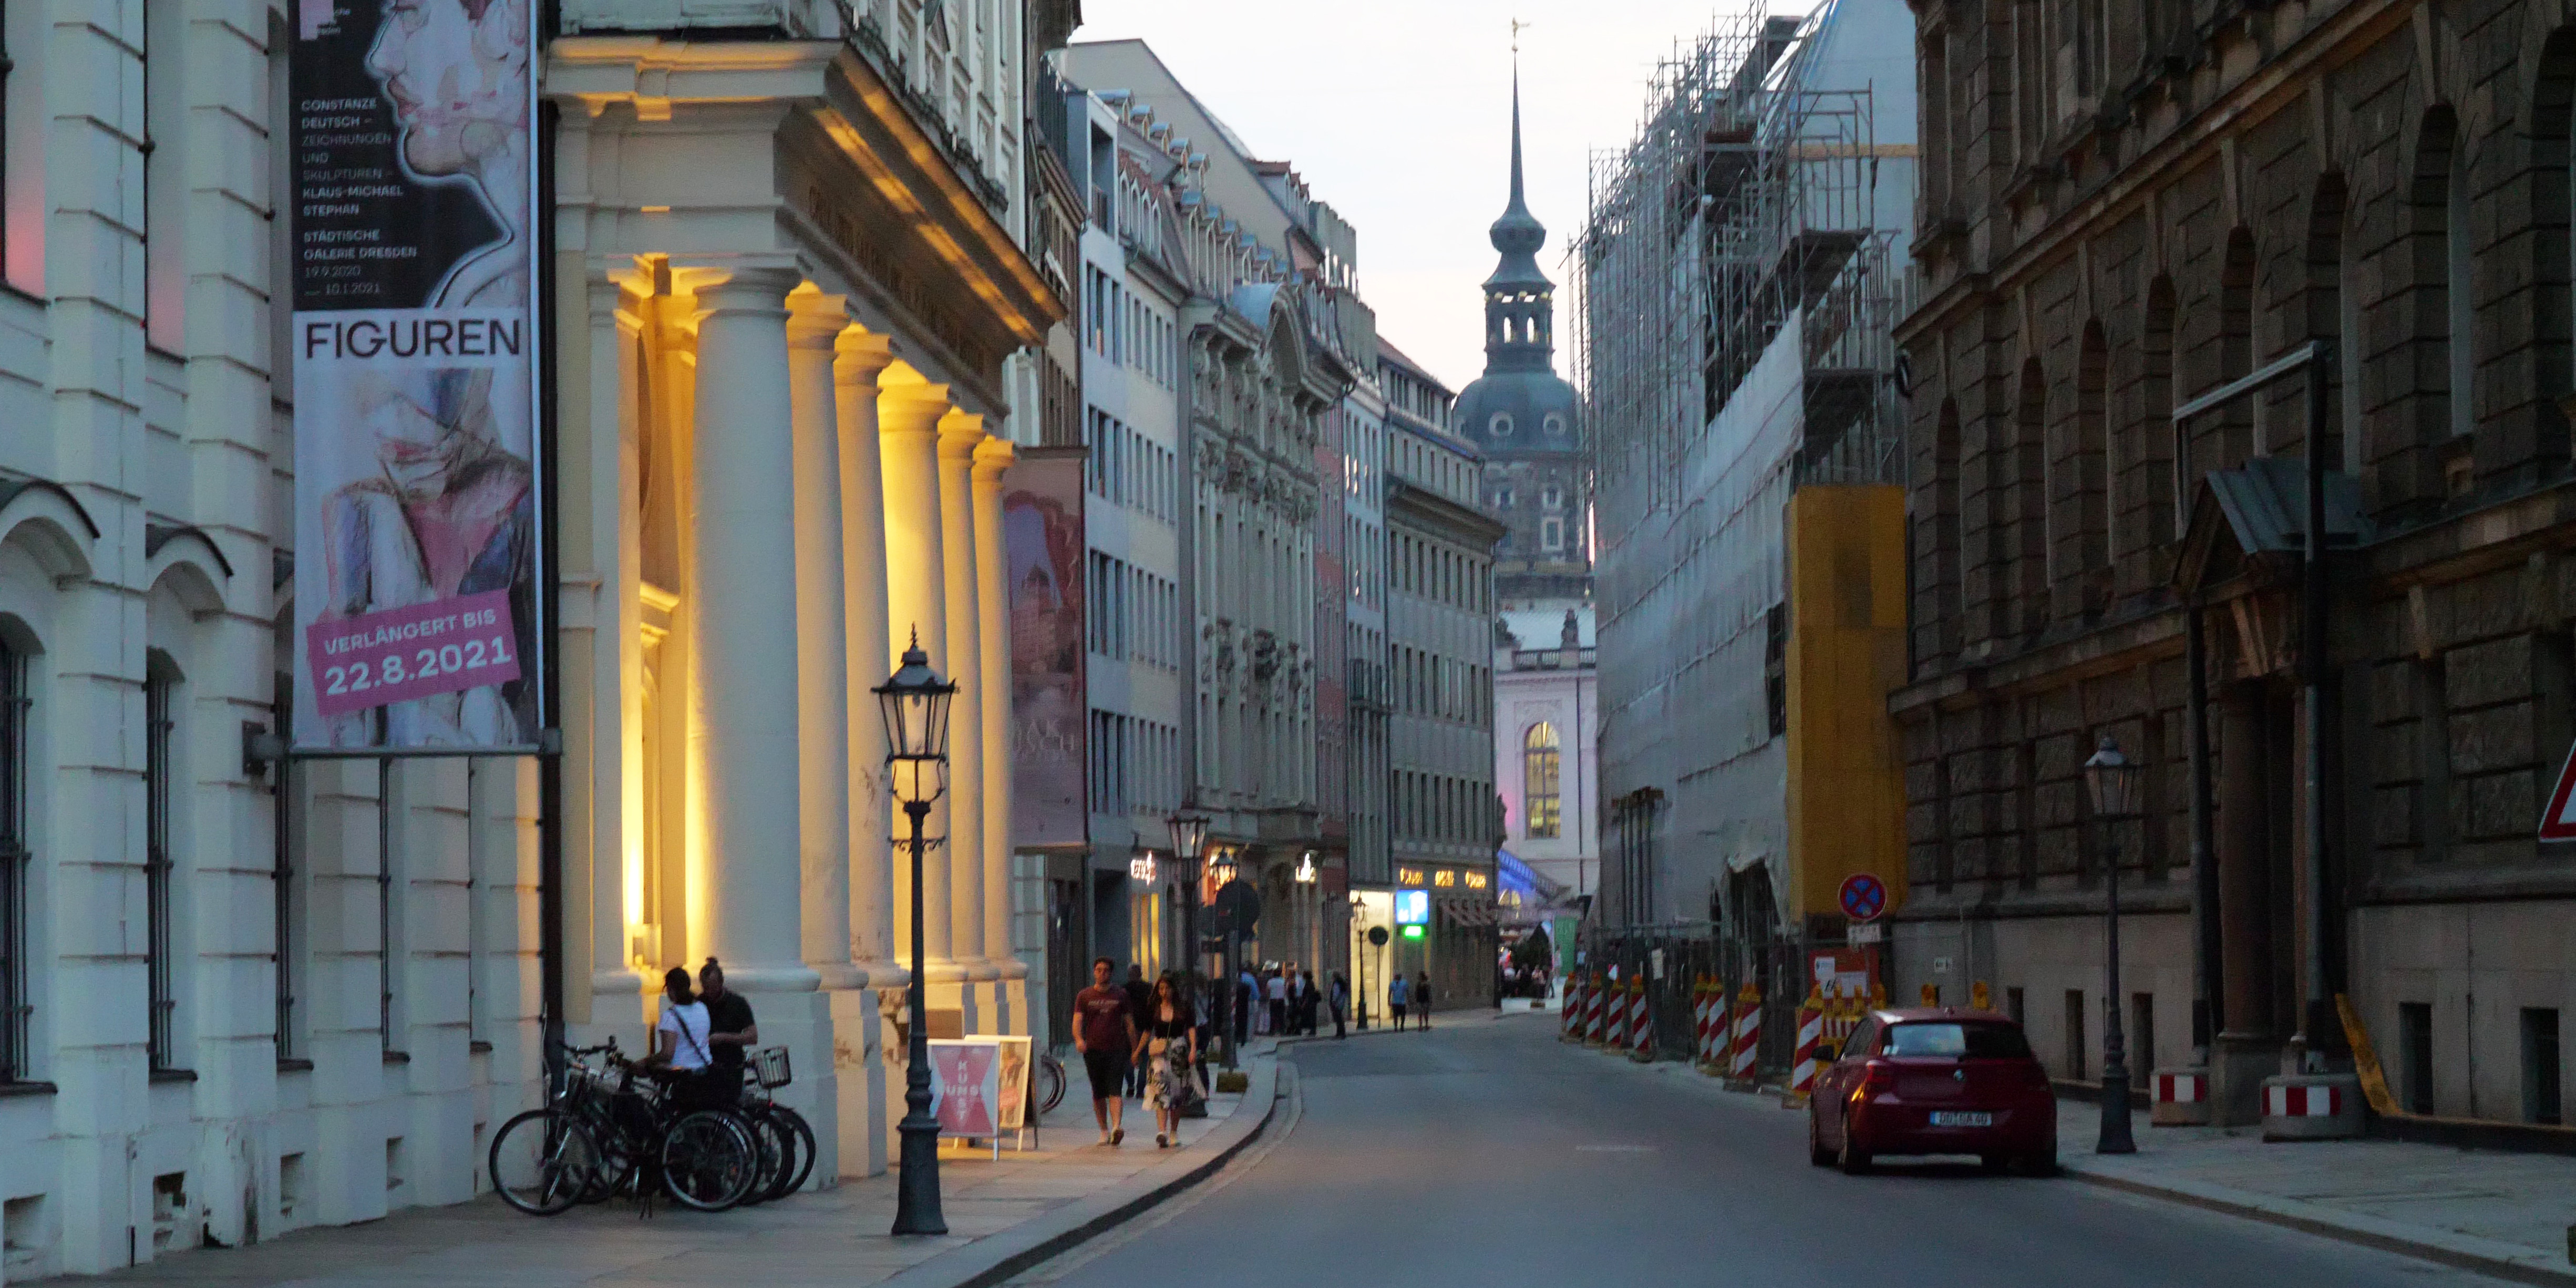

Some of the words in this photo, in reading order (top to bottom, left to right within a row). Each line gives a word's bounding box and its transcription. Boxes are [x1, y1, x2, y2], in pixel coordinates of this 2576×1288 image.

[302, 98, 377, 111] CONSTANZE
[302, 116, 360, 129] DEUTSCH
[302, 132, 391, 147] ZEICHNUNGEN
[302, 152, 329, 163] UND
[303, 168, 382, 181] SKULPTUREN
[303, 185, 403, 199] KLAUS-MICHAEL
[303, 204, 359, 217] STEPHAN
[304, 228, 380, 243] STÄDTISCHE
[304, 248, 355, 260] GALERIE
[359, 245, 417, 259] DRESDEN
[306, 319, 519, 359] FIGUREN
[325, 615, 458, 655] VERLÄNGERT
[463, 609, 496, 629] BIS
[325, 636, 511, 696] 22.8.2021
